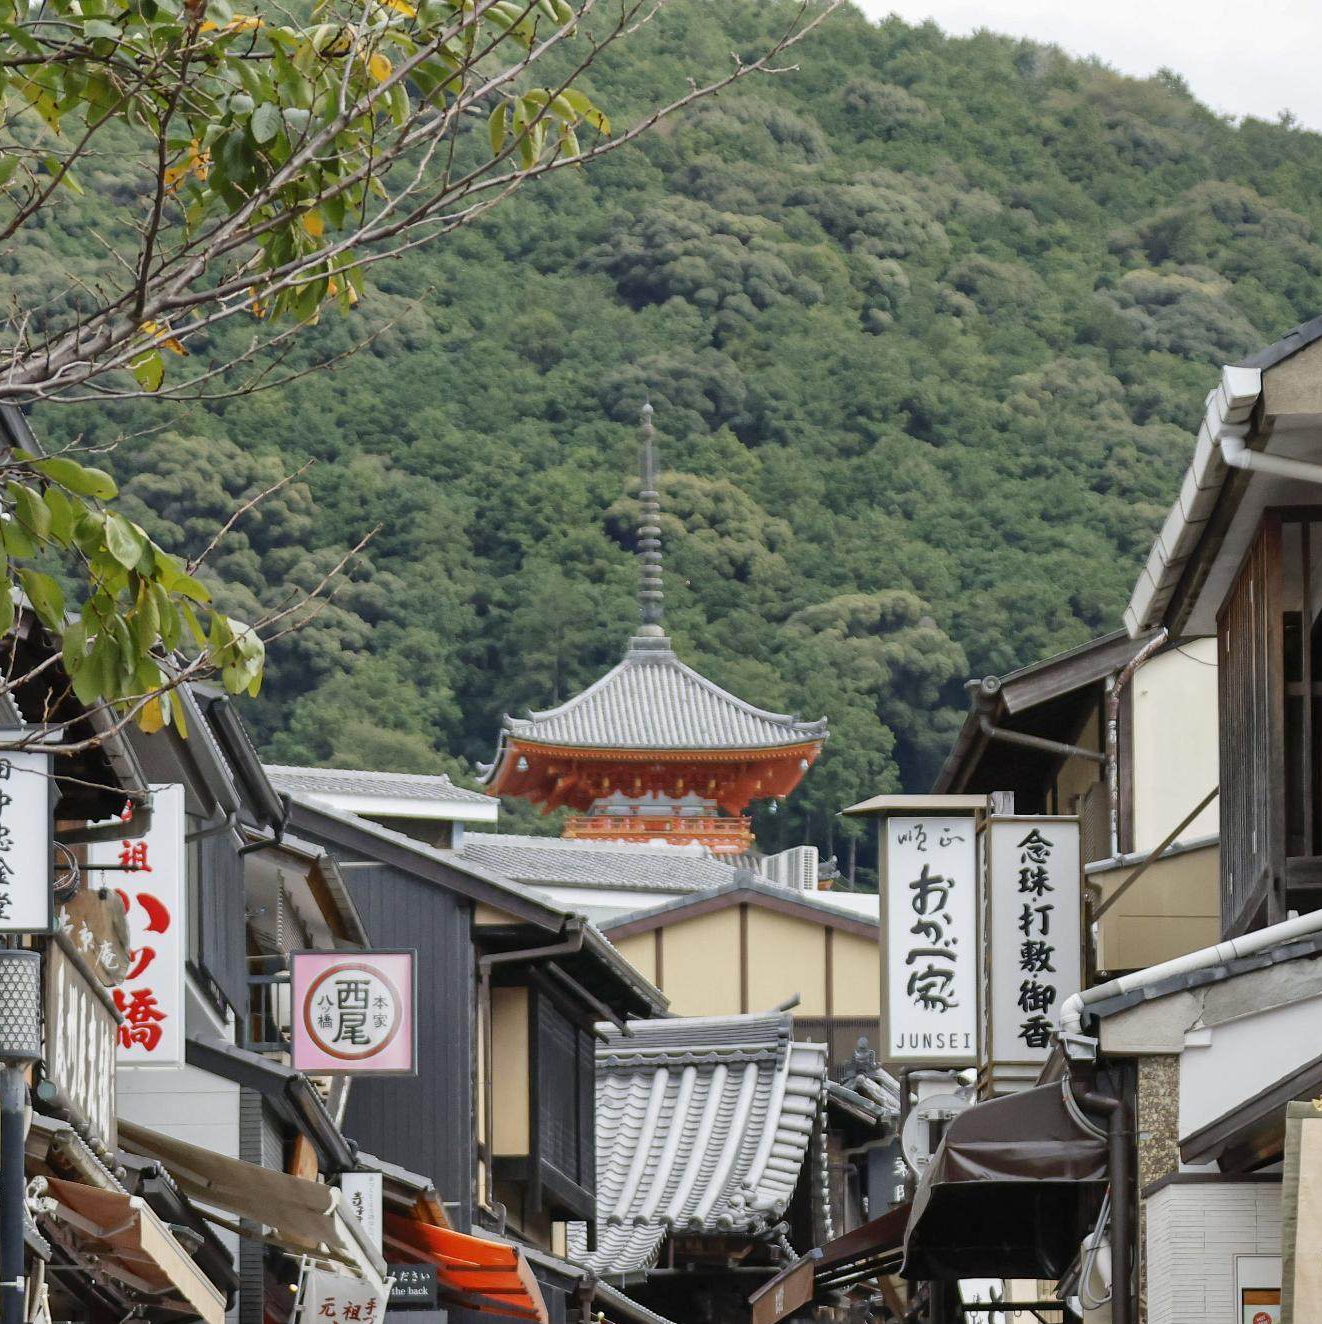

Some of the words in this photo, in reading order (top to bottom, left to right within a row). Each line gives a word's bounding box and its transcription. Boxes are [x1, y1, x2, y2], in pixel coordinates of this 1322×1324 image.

[332, 979, 372, 1045] 西尾
[372, 995, 389, 1029] 本家
[896, 1032, 971, 1049] JUNSEI
[391, 1286, 406, 1296] the
[408, 1284, 429, 1296] back
[318, 1297, 361, 1321] 元祖
